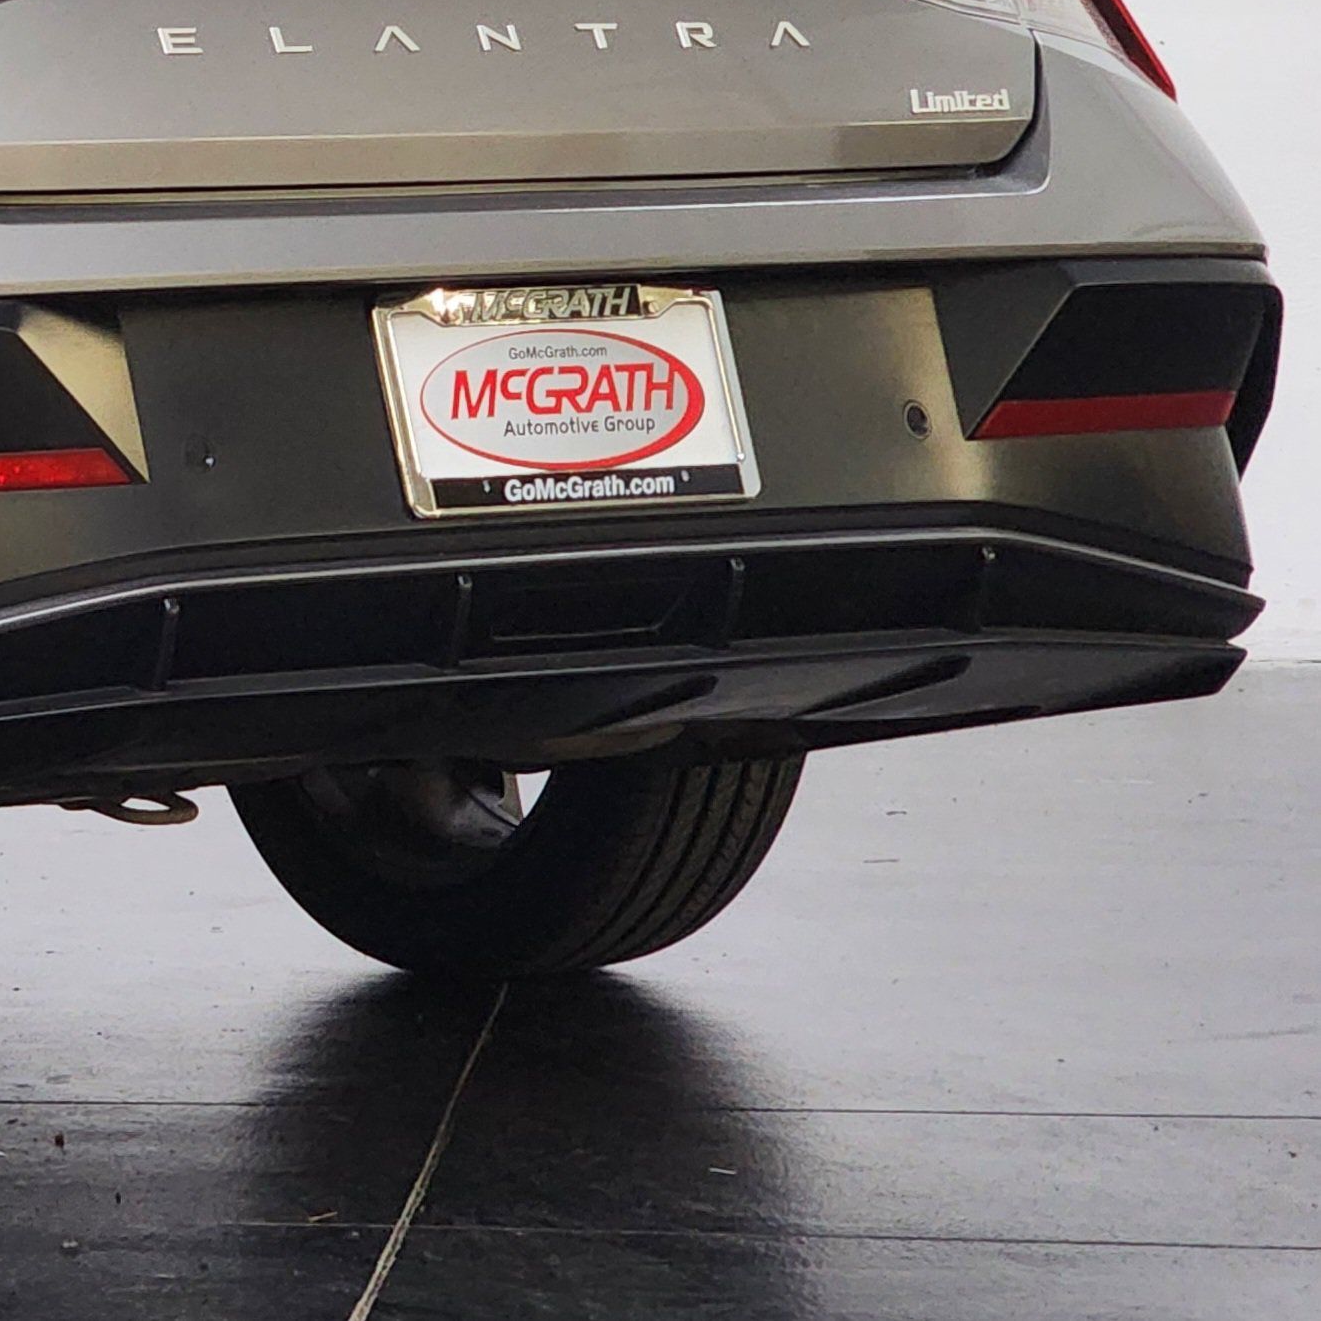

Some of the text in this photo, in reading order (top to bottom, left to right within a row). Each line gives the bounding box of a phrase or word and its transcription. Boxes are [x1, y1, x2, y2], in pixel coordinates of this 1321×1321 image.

[158, 21, 811, 55] ELANTRA
[909, 87, 1011, 115] Limited
[470, 287, 630, 320] McGRATH
[508, 346, 607, 360] GoMcGrath.com
[451, 363, 678, 419] McGRATH
[504, 417, 656, 437] Automotive Group
[504, 476, 675, 502] GoMcGrath.com
